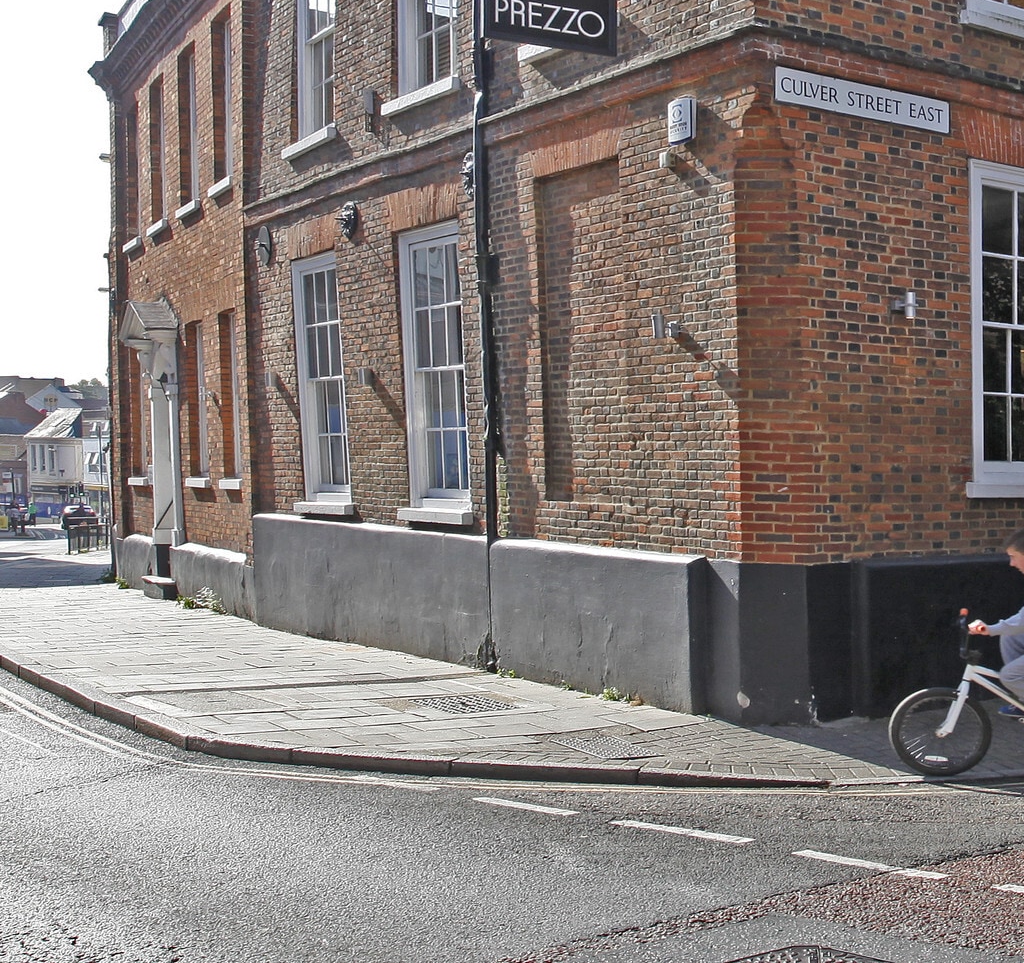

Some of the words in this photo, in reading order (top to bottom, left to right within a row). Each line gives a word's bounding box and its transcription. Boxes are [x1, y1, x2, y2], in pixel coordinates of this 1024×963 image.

[780, 76, 839, 104] CULVER
[847, 91, 902, 115] STREET
[909, 102, 943, 124] EAST
